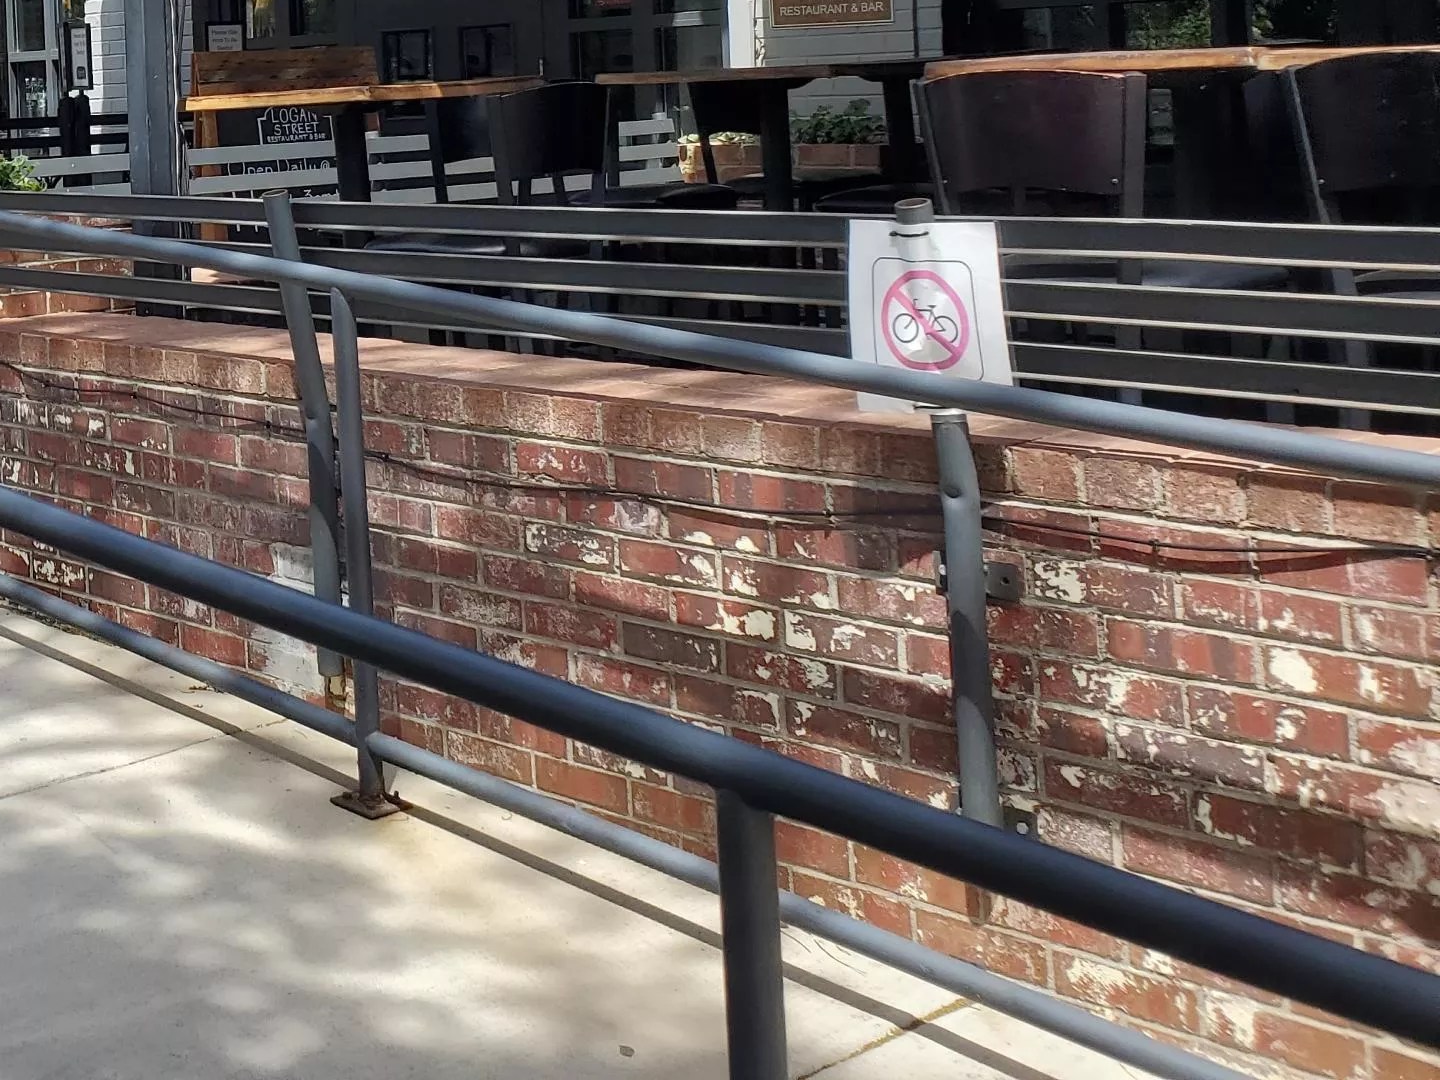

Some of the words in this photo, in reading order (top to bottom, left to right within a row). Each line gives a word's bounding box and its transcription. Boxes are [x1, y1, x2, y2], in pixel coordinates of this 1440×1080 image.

[780, 3, 848, 17] RESTAURANT
[851, 3, 858, 13] &
[861, 1, 884, 12] BAR
[273, 121, 319, 136] STREET
[267, 133, 308, 143] RESTAURANT
